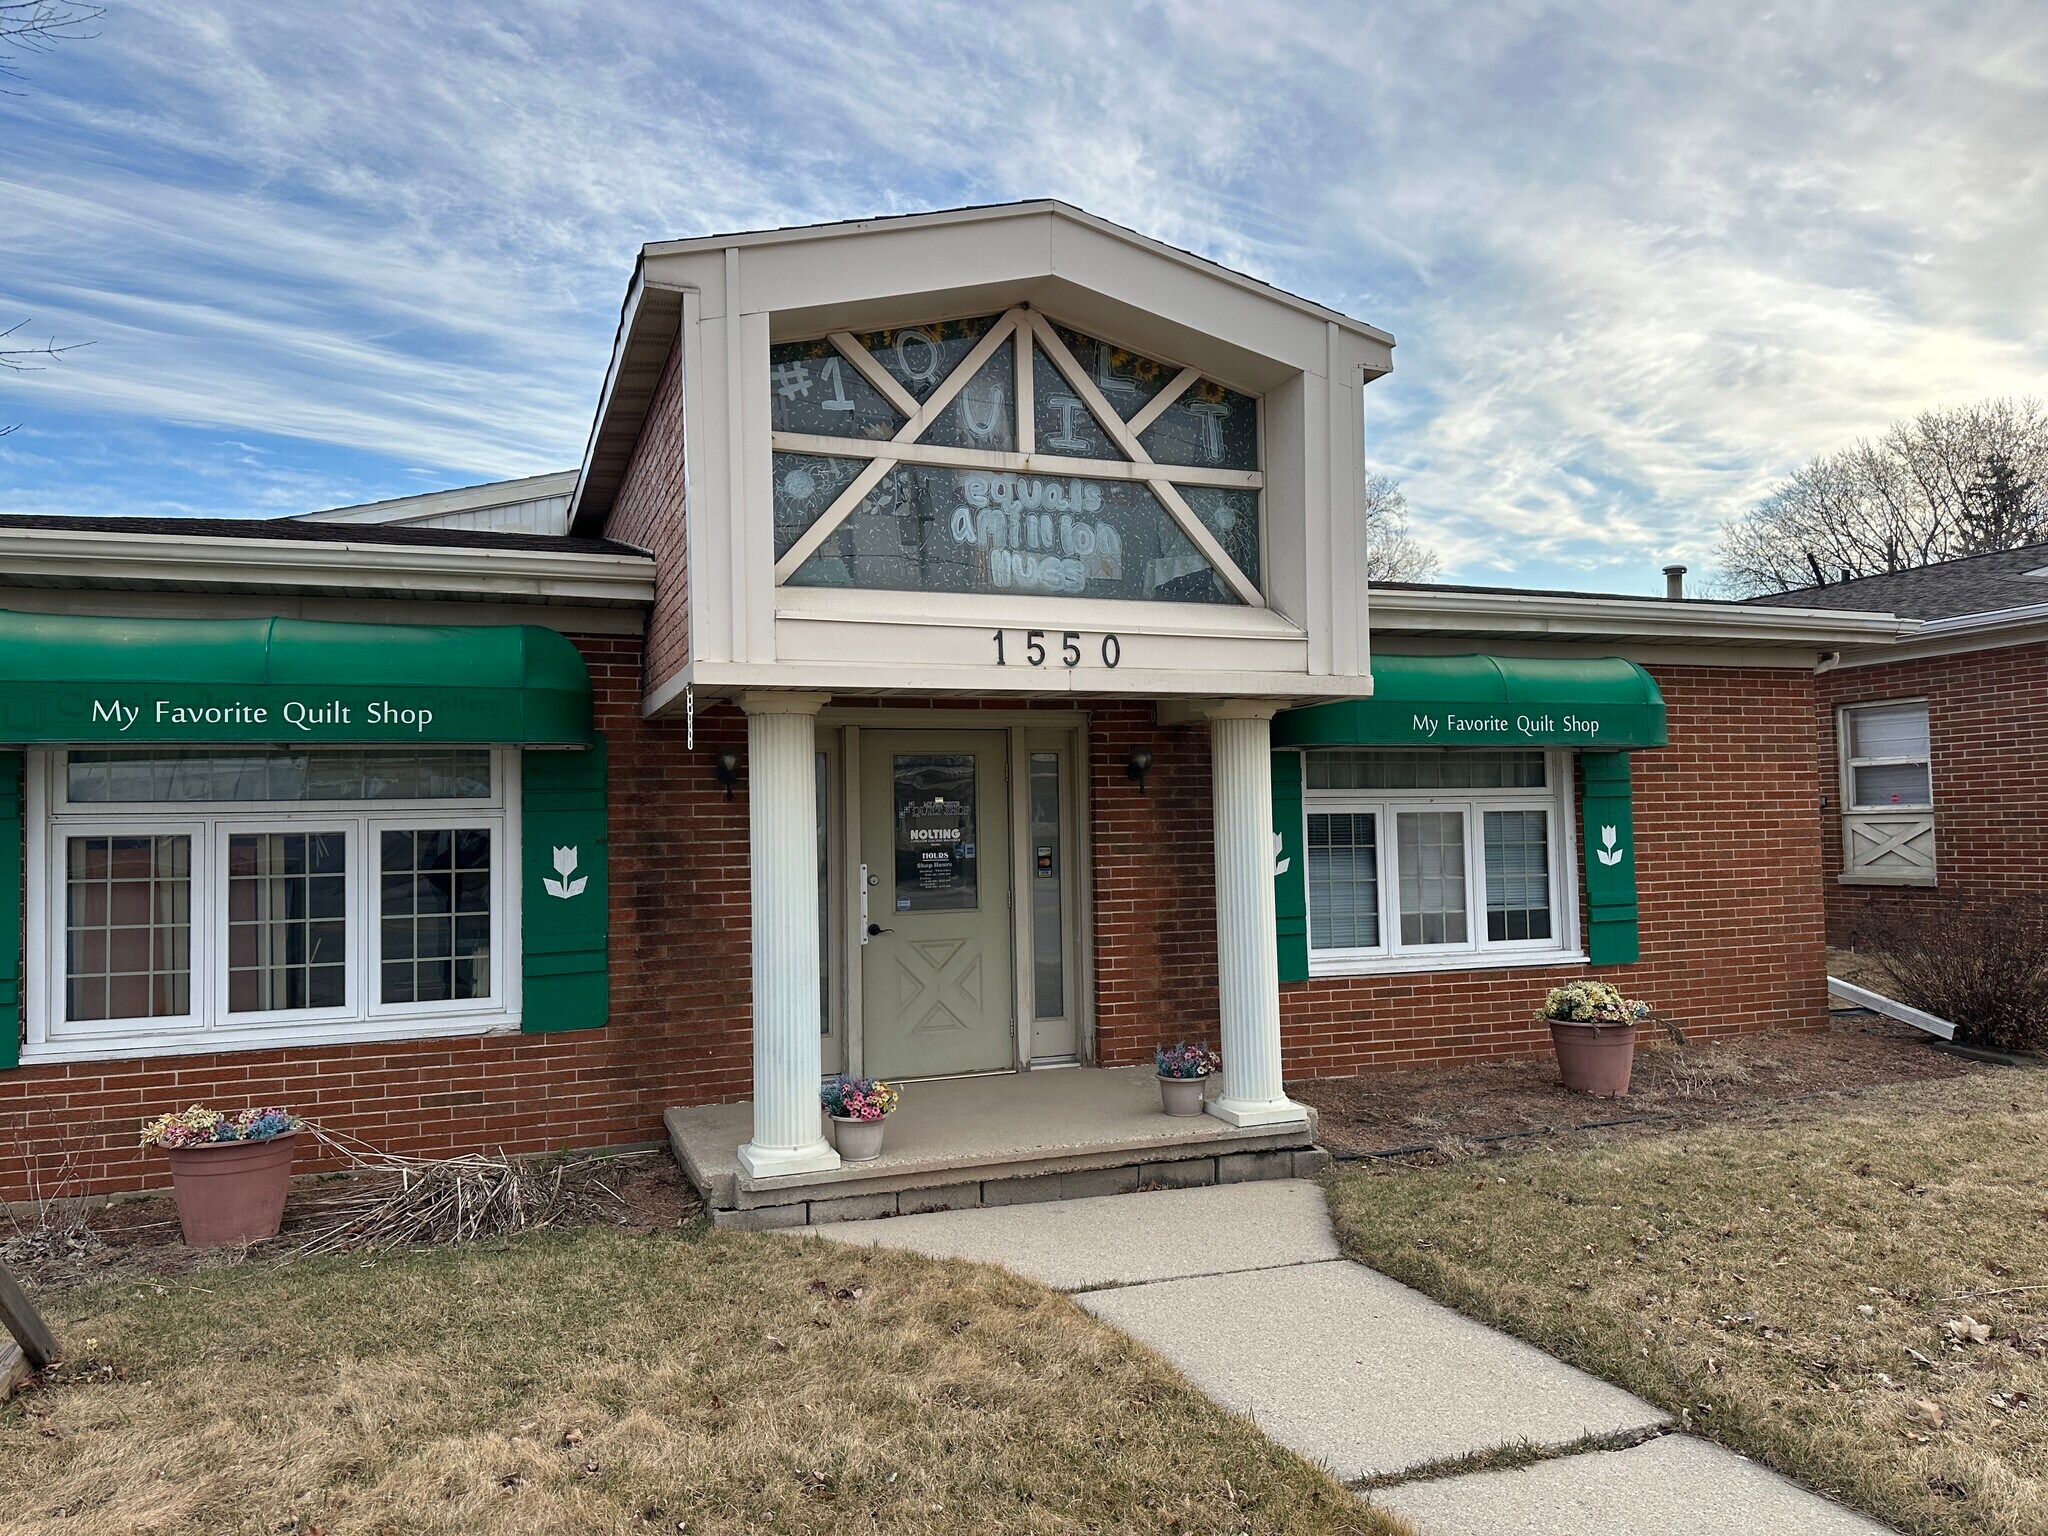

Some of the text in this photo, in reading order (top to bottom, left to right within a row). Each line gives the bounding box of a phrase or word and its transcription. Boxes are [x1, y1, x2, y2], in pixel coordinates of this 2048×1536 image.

[770, 356, 855, 411] #1
[963, 476, 1105, 515] equals
[993, 629, 1120, 668] 1550
[92, 700, 139, 731] My
[155, 701, 268, 724] Favorite
[283, 701, 351, 731] Quilt
[367, 701, 433, 732] Shop
[1413, 714, 1599, 737] My Favorite Quilt Shop
[910, 829, 960, 840] NOLTING
